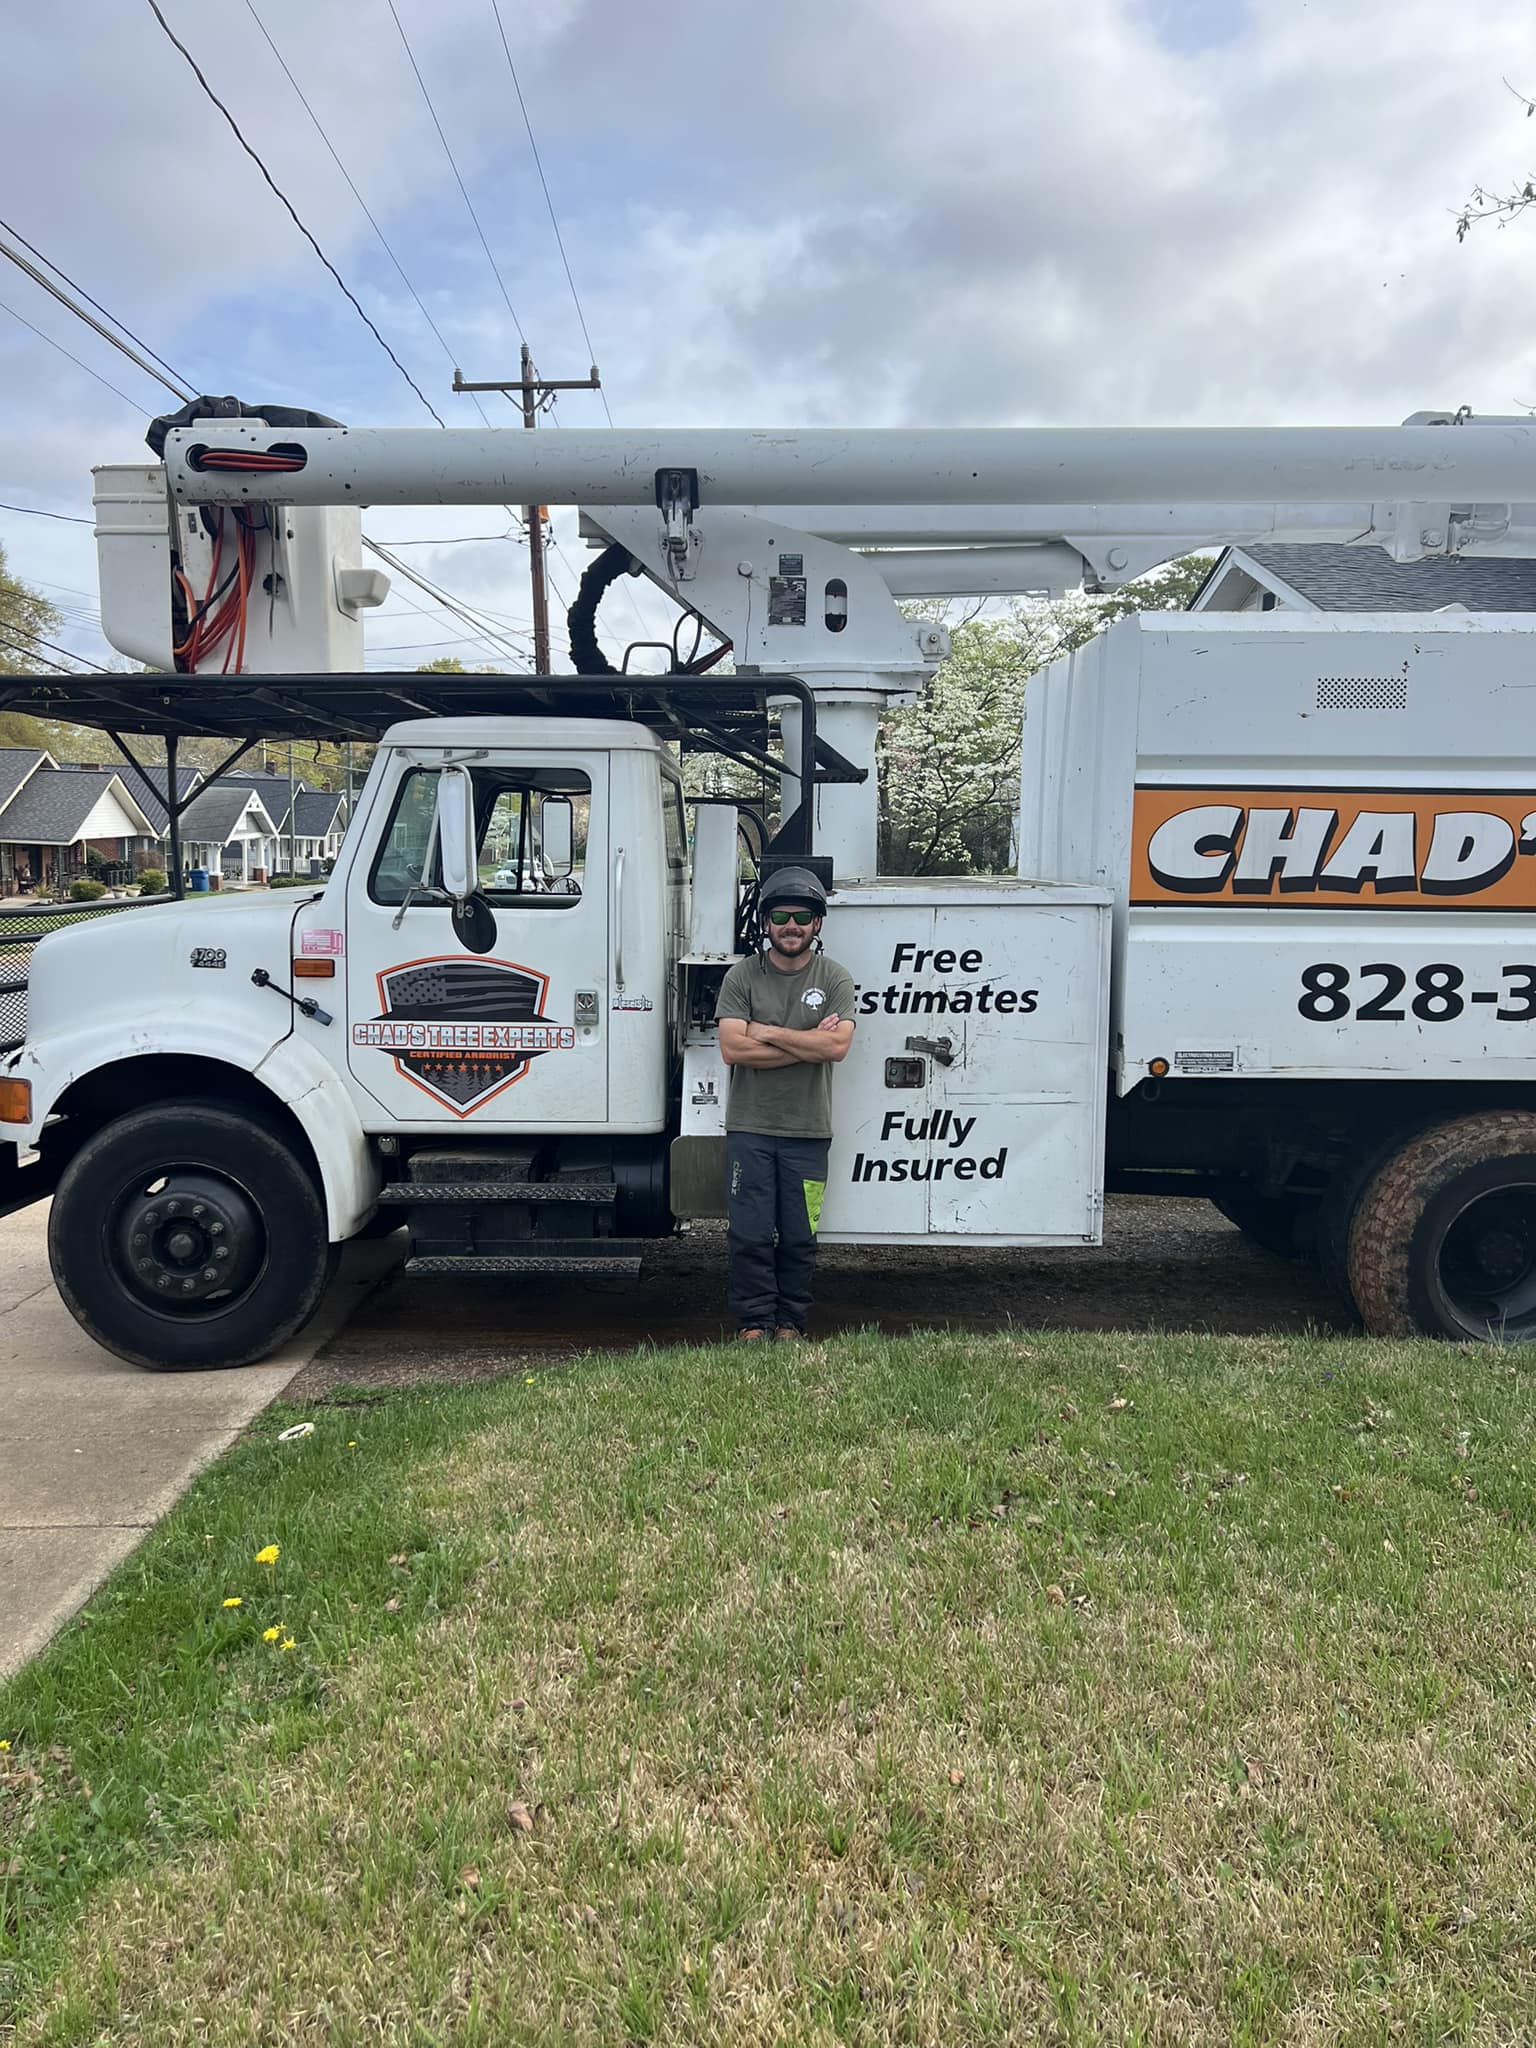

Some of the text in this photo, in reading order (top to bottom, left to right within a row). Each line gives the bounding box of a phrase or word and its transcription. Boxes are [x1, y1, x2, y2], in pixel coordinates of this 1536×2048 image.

[890, 942, 983, 973] Free
[1297, 962, 1536, 1023] 828-3
[353, 1023, 575, 1049] CHAD'S TREE EXPERTS
[409, 1051, 517, 1060] CERTIFIED ARBORIST
[880, 1109, 977, 1148] Fully
[851, 1147, 1008, 1182] Insured
